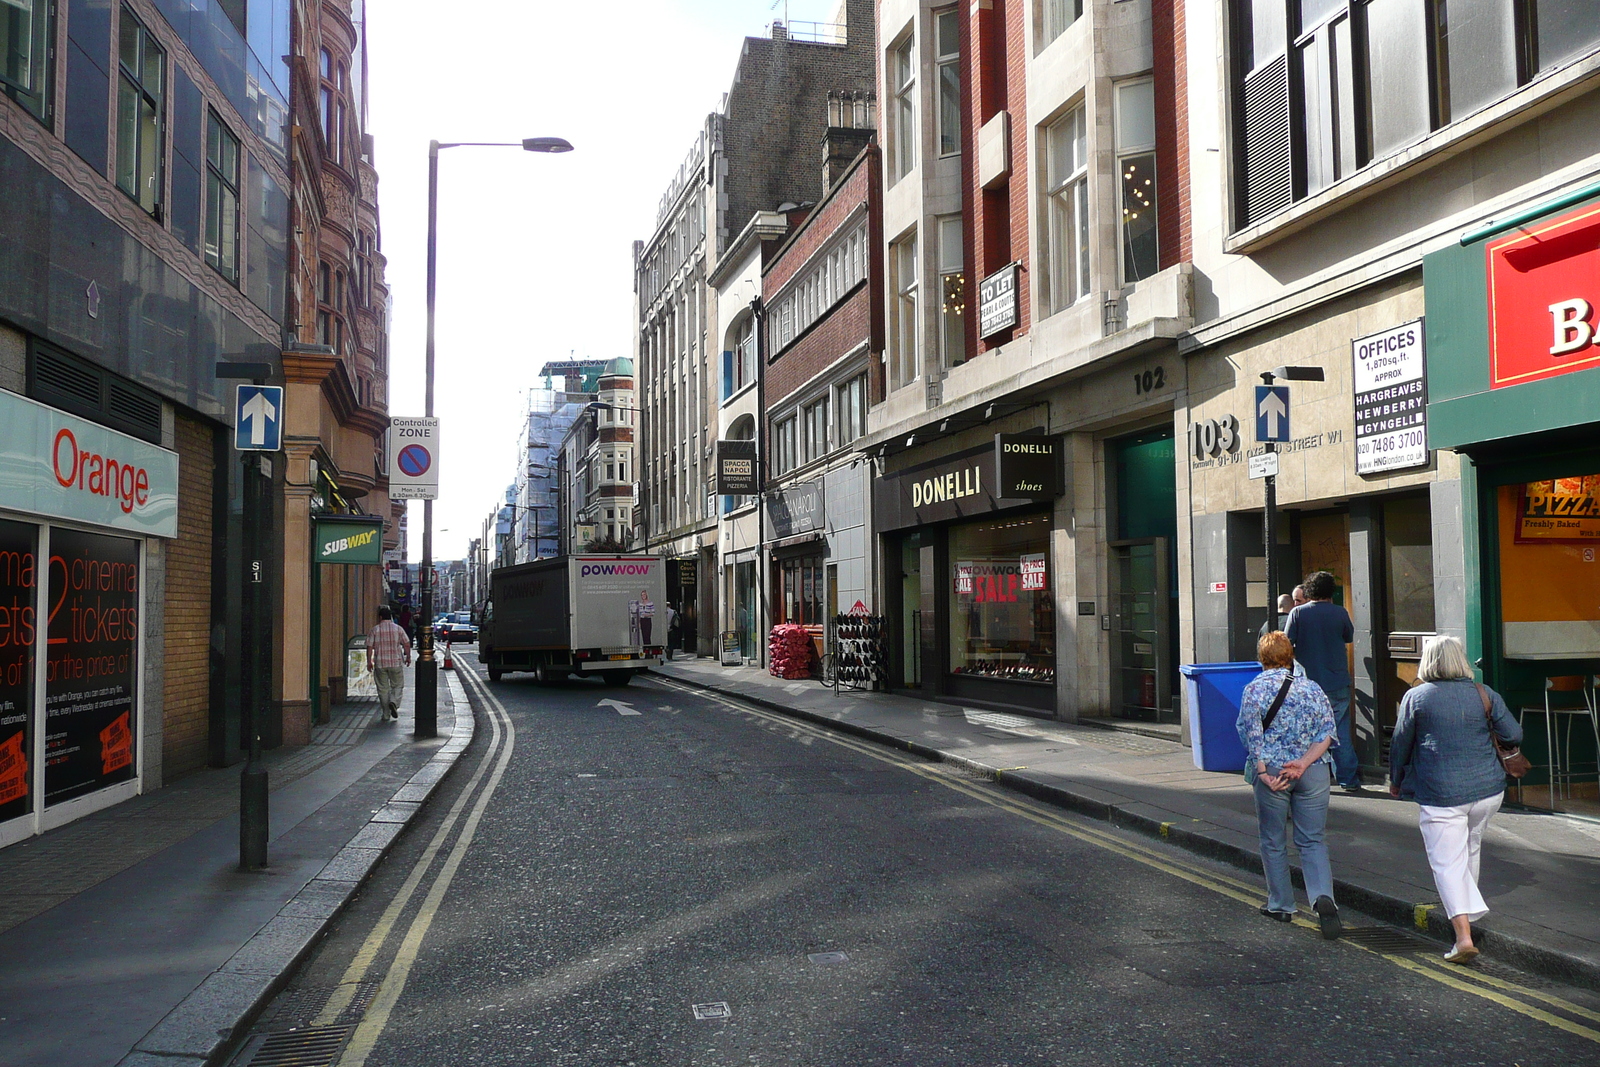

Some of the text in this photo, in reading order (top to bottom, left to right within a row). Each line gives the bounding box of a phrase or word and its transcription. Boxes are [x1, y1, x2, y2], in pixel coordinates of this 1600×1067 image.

[981, 274, 1013, 304] TO LET
[994, 301, 998, 312] &
[999, 293, 1015, 310] COUTTS
[1548, 298, 1600, 355] B
[1359, 330, 1415, 361] OFFICES
[1134, 365, 1165, 395] 102
[1374, 368, 1402, 383] APPROX
[1356, 380, 1423, 406] HARGREAVES
[1356, 396, 1423, 420] NEWBERRY
[393, 418, 438, 427] Controlled
[1365, 416, 1415, 434] GYNGELL
[399, 428, 431, 437] ZONE
[1188, 413, 1237, 458] 103
[1358, 429, 1423, 455] 020 7486 3700
[1003, 443, 1053, 454] DONELLI
[1193, 429, 1343, 470] formerly 91-101 OXFD STREET W1
[53, 428, 149, 514] Orange
[912, 465, 981, 508] DONELLI
[1015, 480, 1043, 491] shoes
[1524, 520, 1555, 529] Freshly
[322, 530, 377, 556] SUBWAY
[252, 562, 260, 571] S
[581, 565, 650, 578] powwow
[961, 565, 973, 575] PRICE
[1030, 559, 1045, 569] PRICE
[253, 572, 258, 581] 1
[955, 577, 972, 592] SALE
[1022, 572, 1044, 589] SALE
[47, 548, 137, 645] 2 cinema
[975, 573, 1018, 603] SALE
[71, 594, 137, 643] tickets
[7, 654, 23, 686] of
[46, 659, 59, 682] or
[63, 652, 84, 680] the
[87, 649, 115, 683] price
[117, 647, 129, 674] of
[83, 690, 92, 700] you
[60, 705, 72, 716] every
[72, 700, 94, 713] Wednesday
[94, 700, 99, 709] at
[99, 697, 114, 709] cinemas
[1, 711, 28, 726] nationwide
